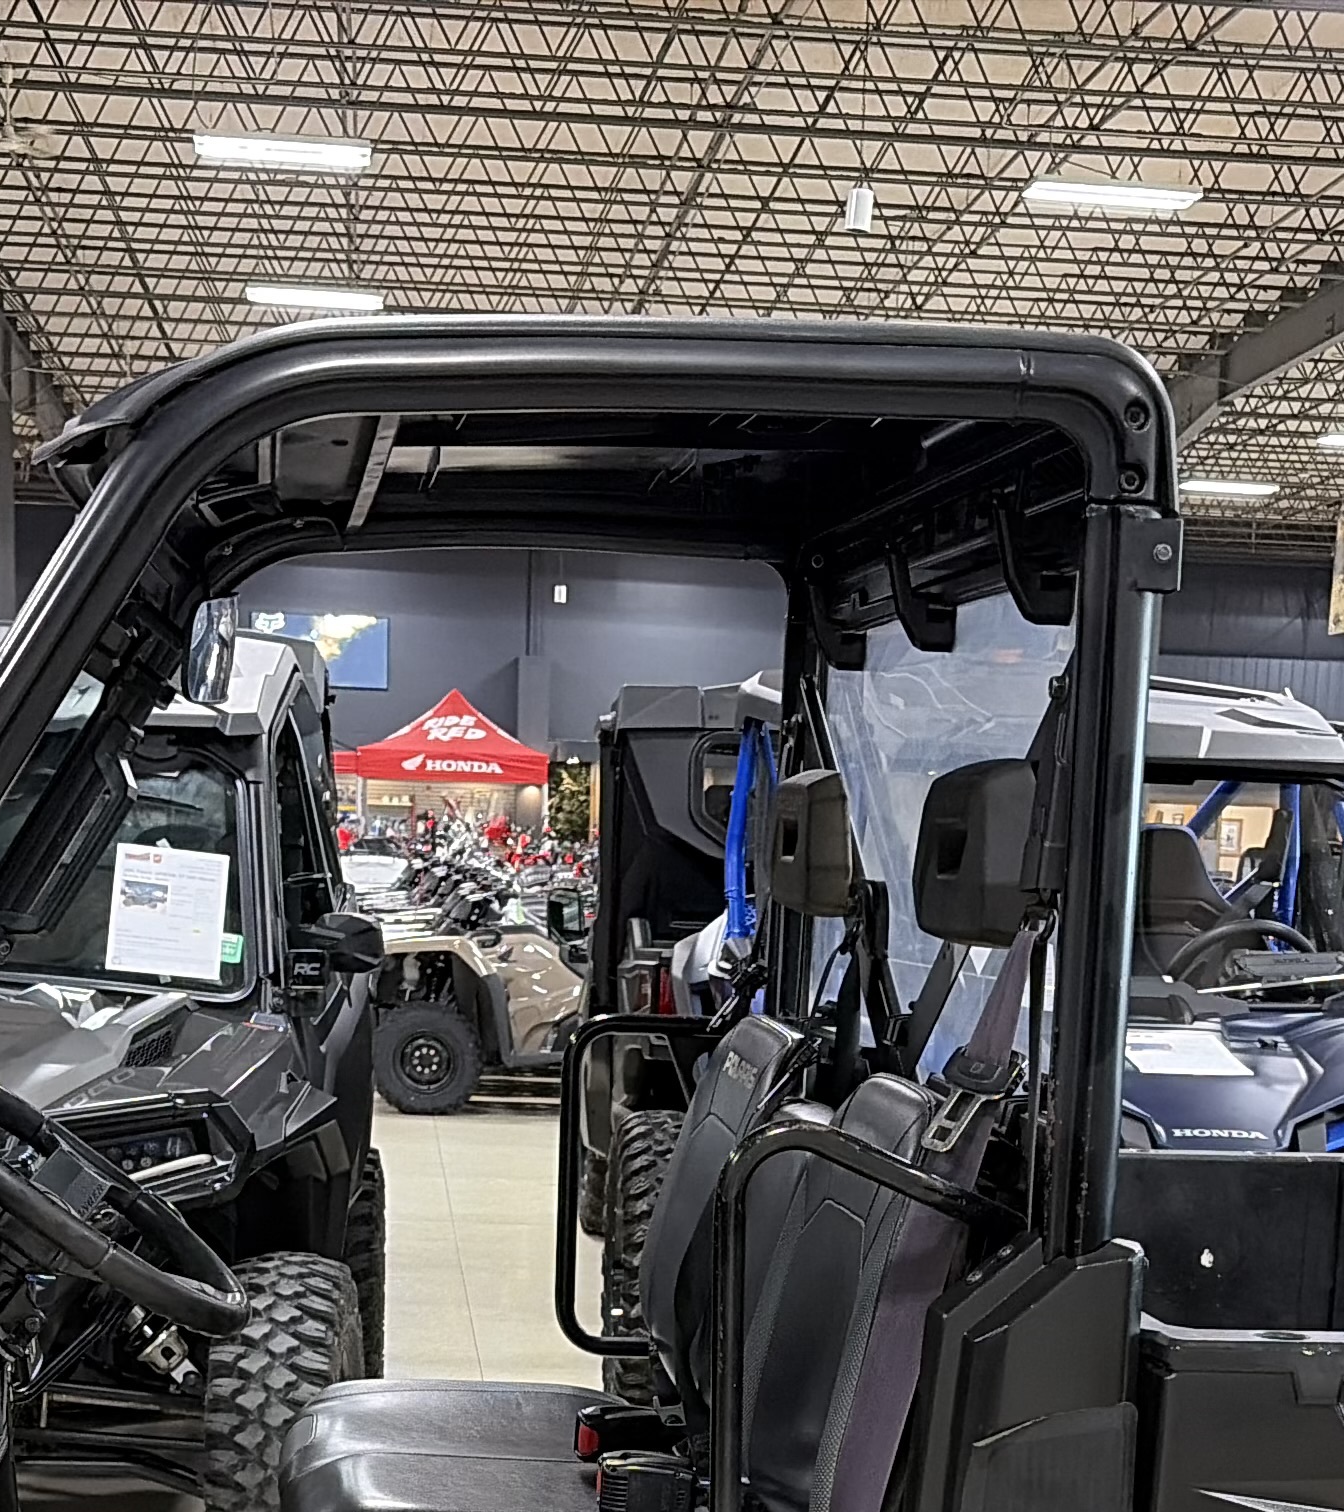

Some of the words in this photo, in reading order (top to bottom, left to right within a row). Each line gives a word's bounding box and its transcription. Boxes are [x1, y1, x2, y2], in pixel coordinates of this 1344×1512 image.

[422, 714, 478, 731] RIDE
[427, 726, 487, 742] RED
[425, 758, 504, 774] HONDA
[293, 963, 321, 976] RC
[1171, 1128, 1269, 1140] HONDA
